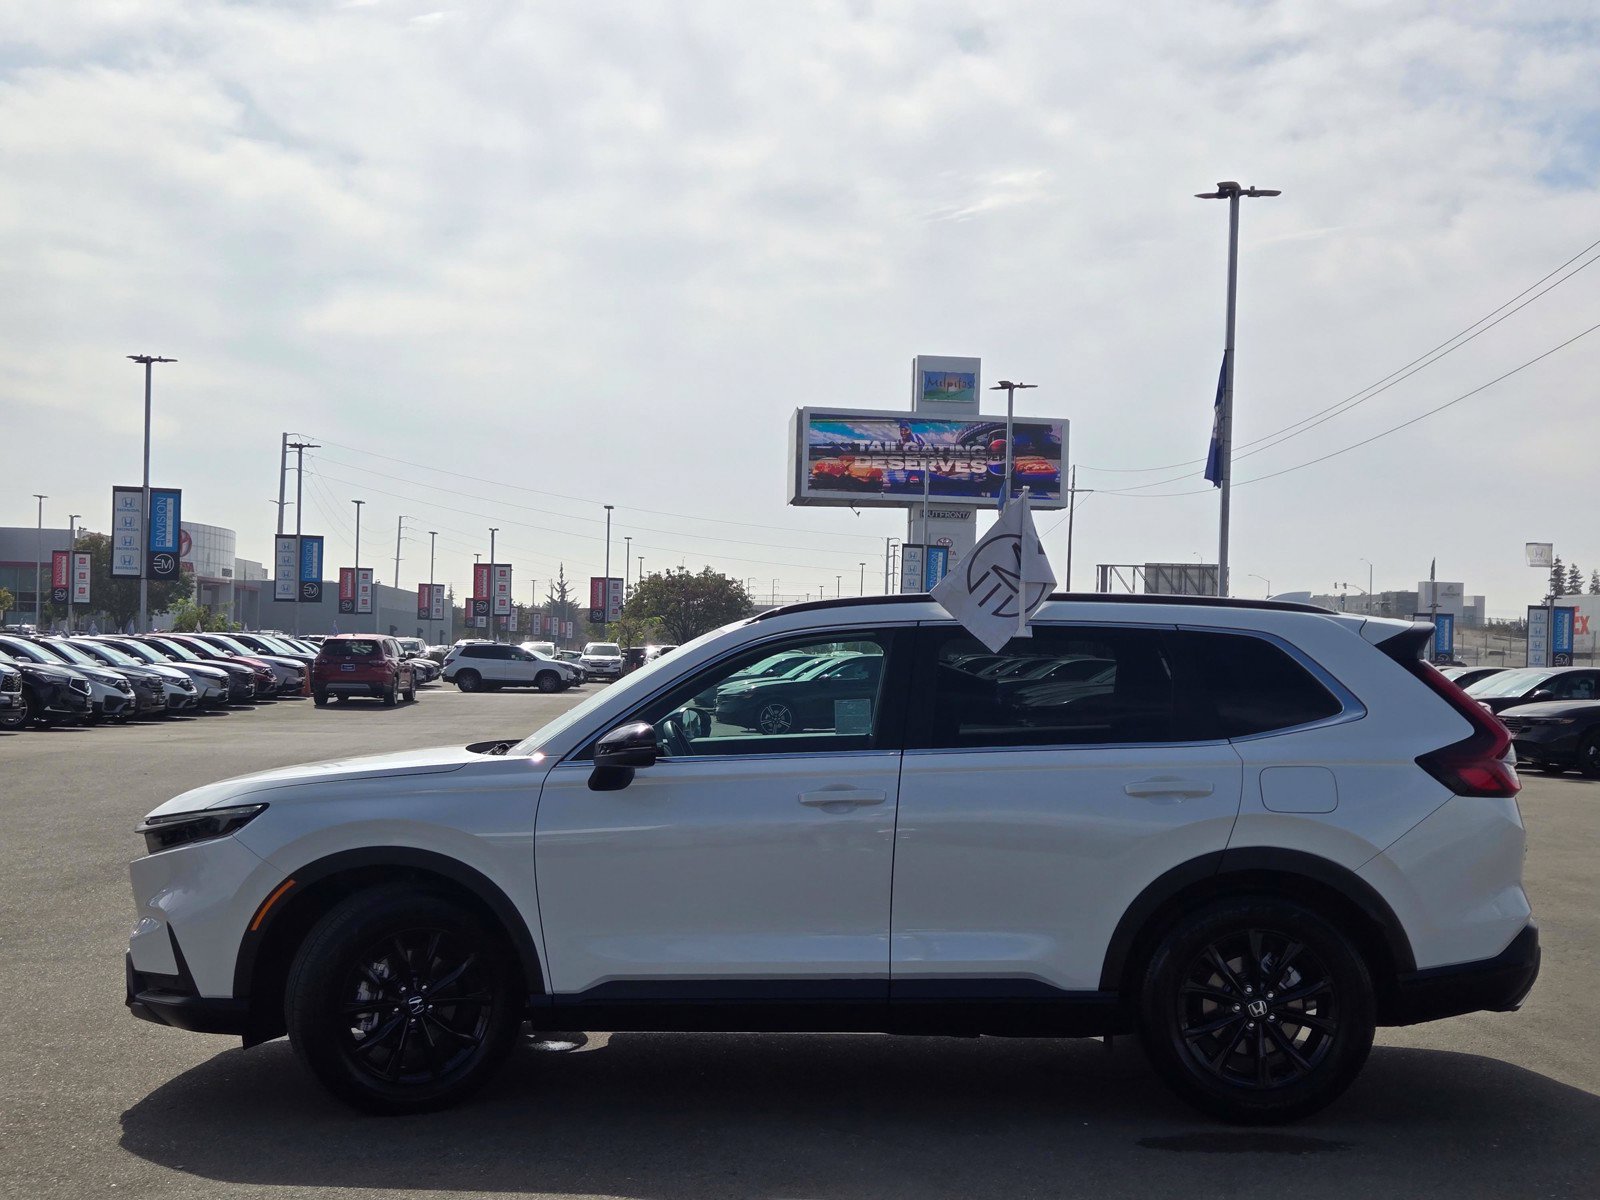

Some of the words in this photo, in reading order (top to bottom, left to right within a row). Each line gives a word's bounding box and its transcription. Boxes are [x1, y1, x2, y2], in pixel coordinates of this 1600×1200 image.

[854, 440, 986, 456] TAILGATING
[854, 456, 988, 473] DESERVES
[155, 496, 167, 547] ENVISION
